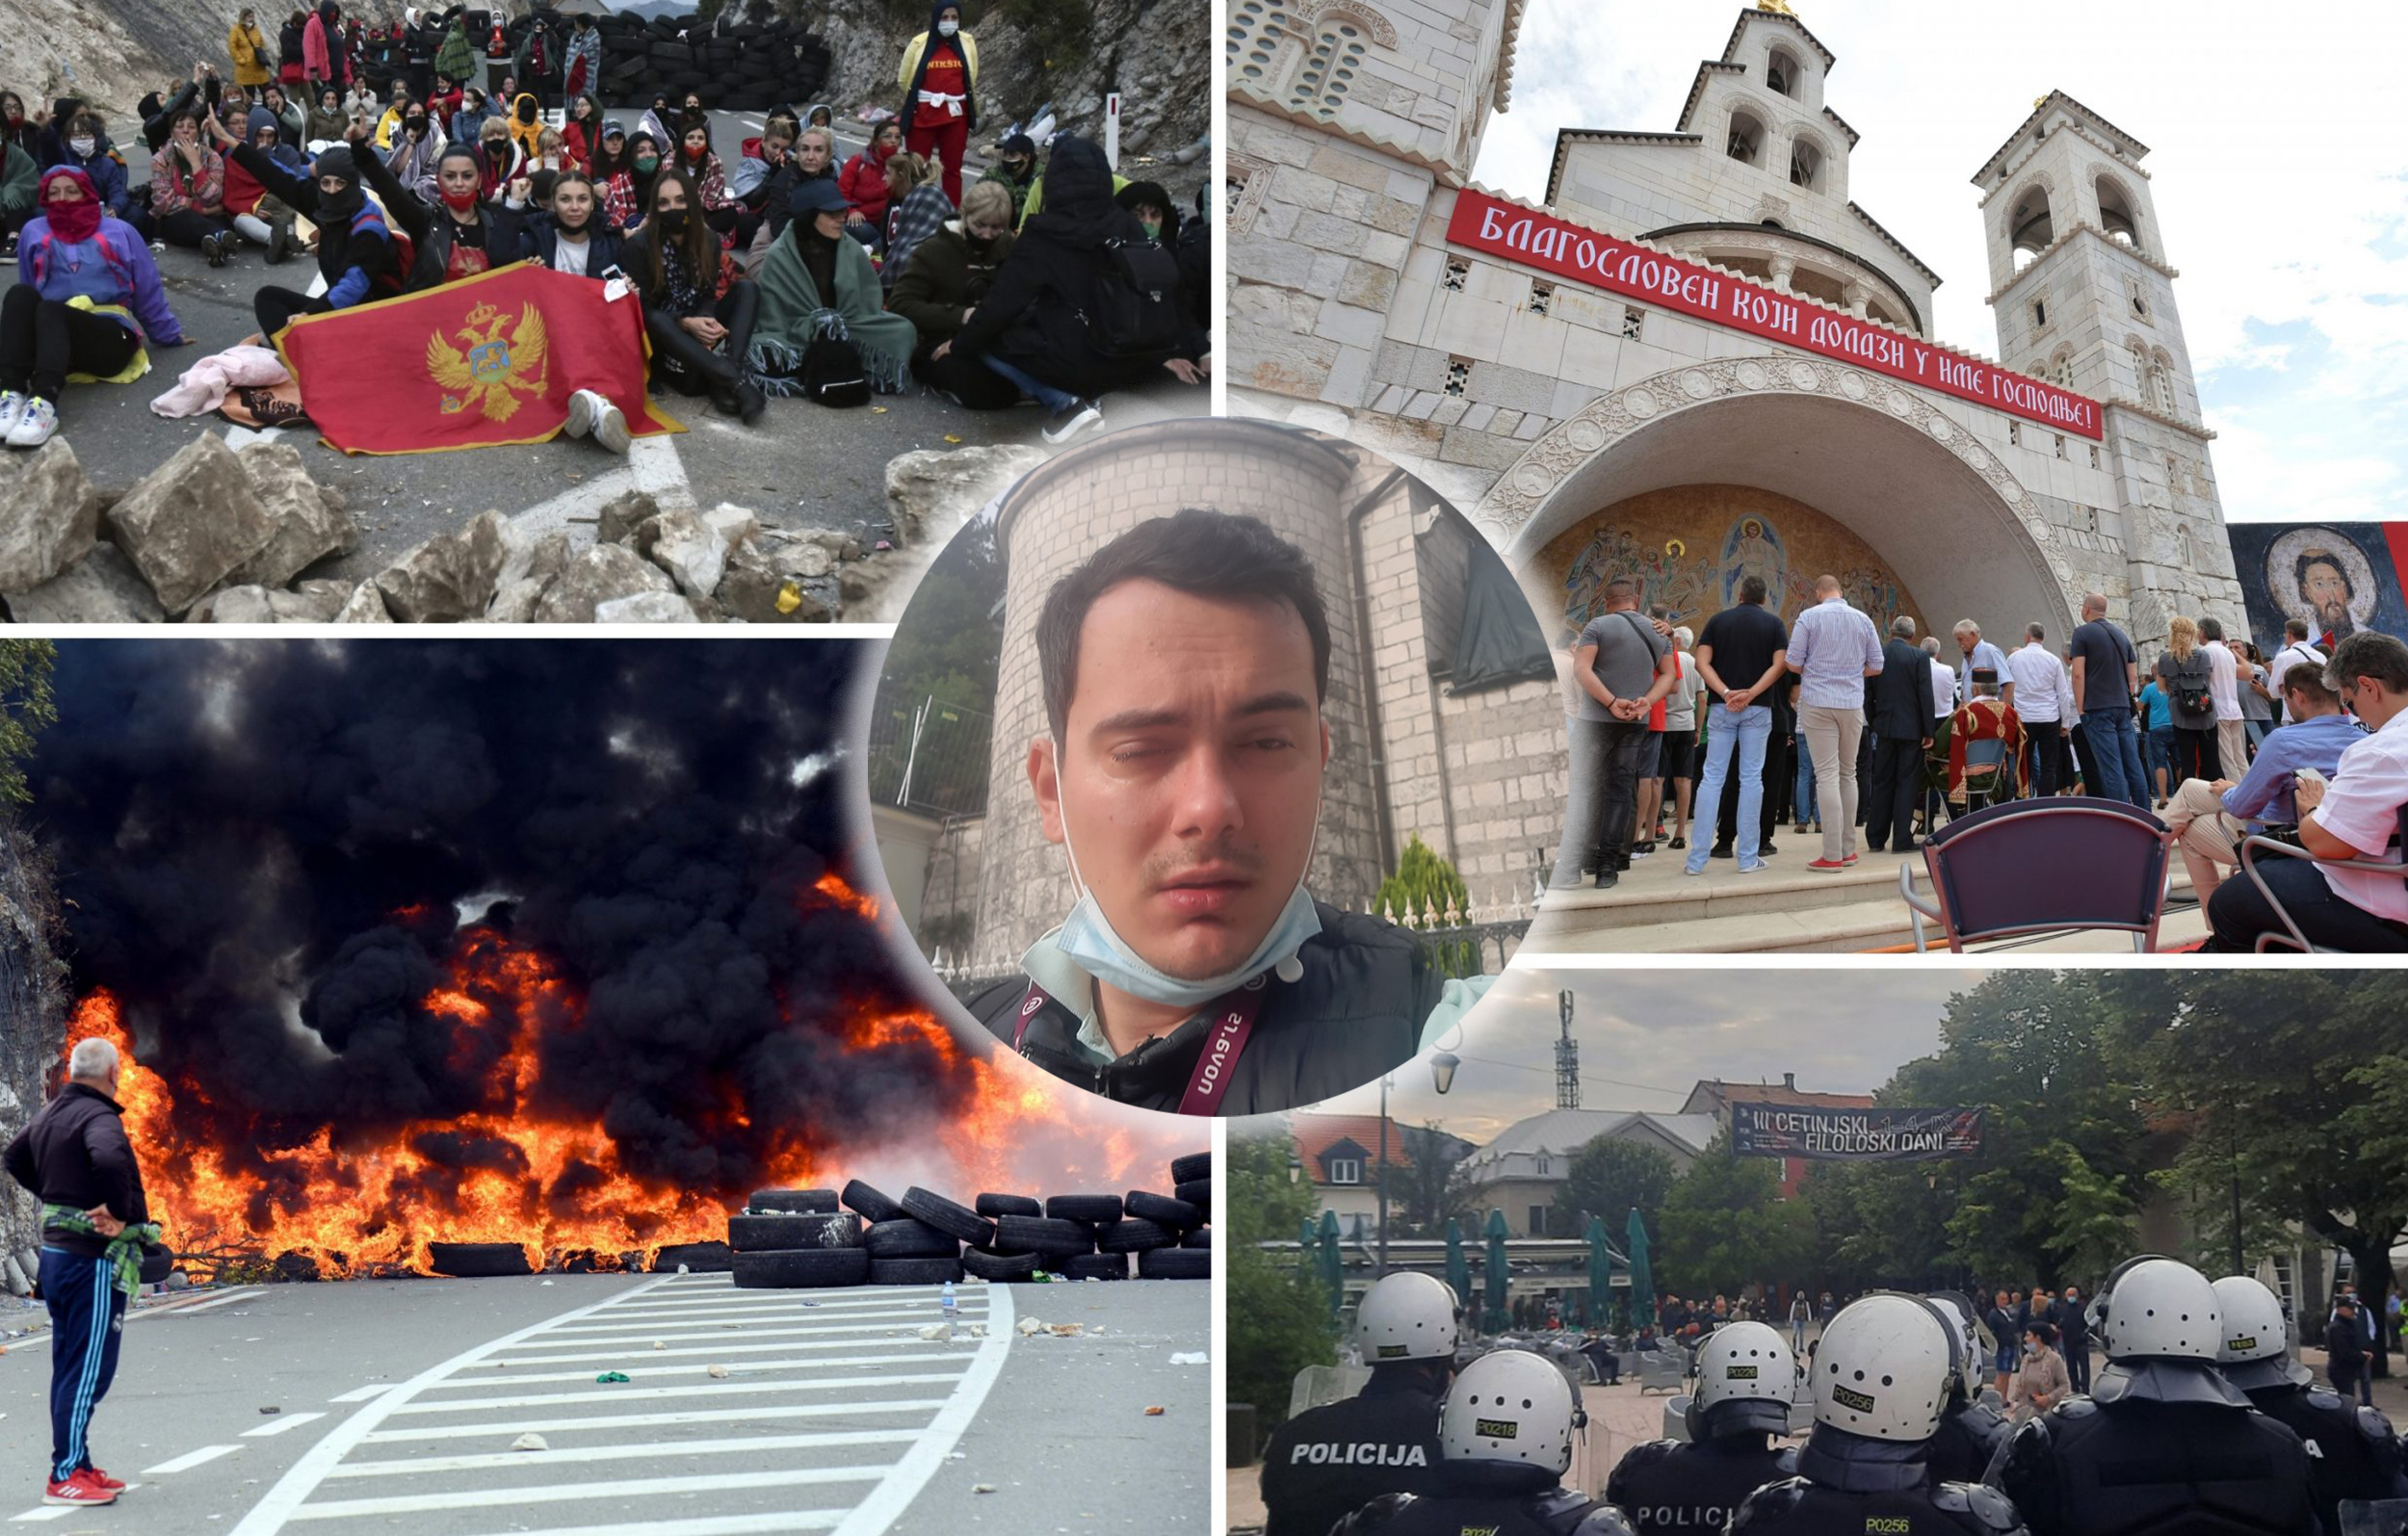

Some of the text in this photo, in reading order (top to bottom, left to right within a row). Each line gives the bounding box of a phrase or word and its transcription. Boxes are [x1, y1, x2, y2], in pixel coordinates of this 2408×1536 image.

[1479, 207, 1719, 310] БЛАГОСЛОВЕН
[1914, 347, 1929, 376] У
[1753, 1110, 1770, 1131] III
[1775, 1111, 1869, 1135] CETINJSKI
[1805, 1130, 1896, 1153] FILOLOŠKI
[1901, 1132, 1943, 1152] DANI
[1835, 1388, 1873, 1411] P0256
[1477, 1420, 1517, 1437] P0218
[1290, 1443, 1427, 1467] POLICIJA
[1637, 1506, 1734, 1525] POLICI
[1866, 1519, 1909, 1533] P0256
